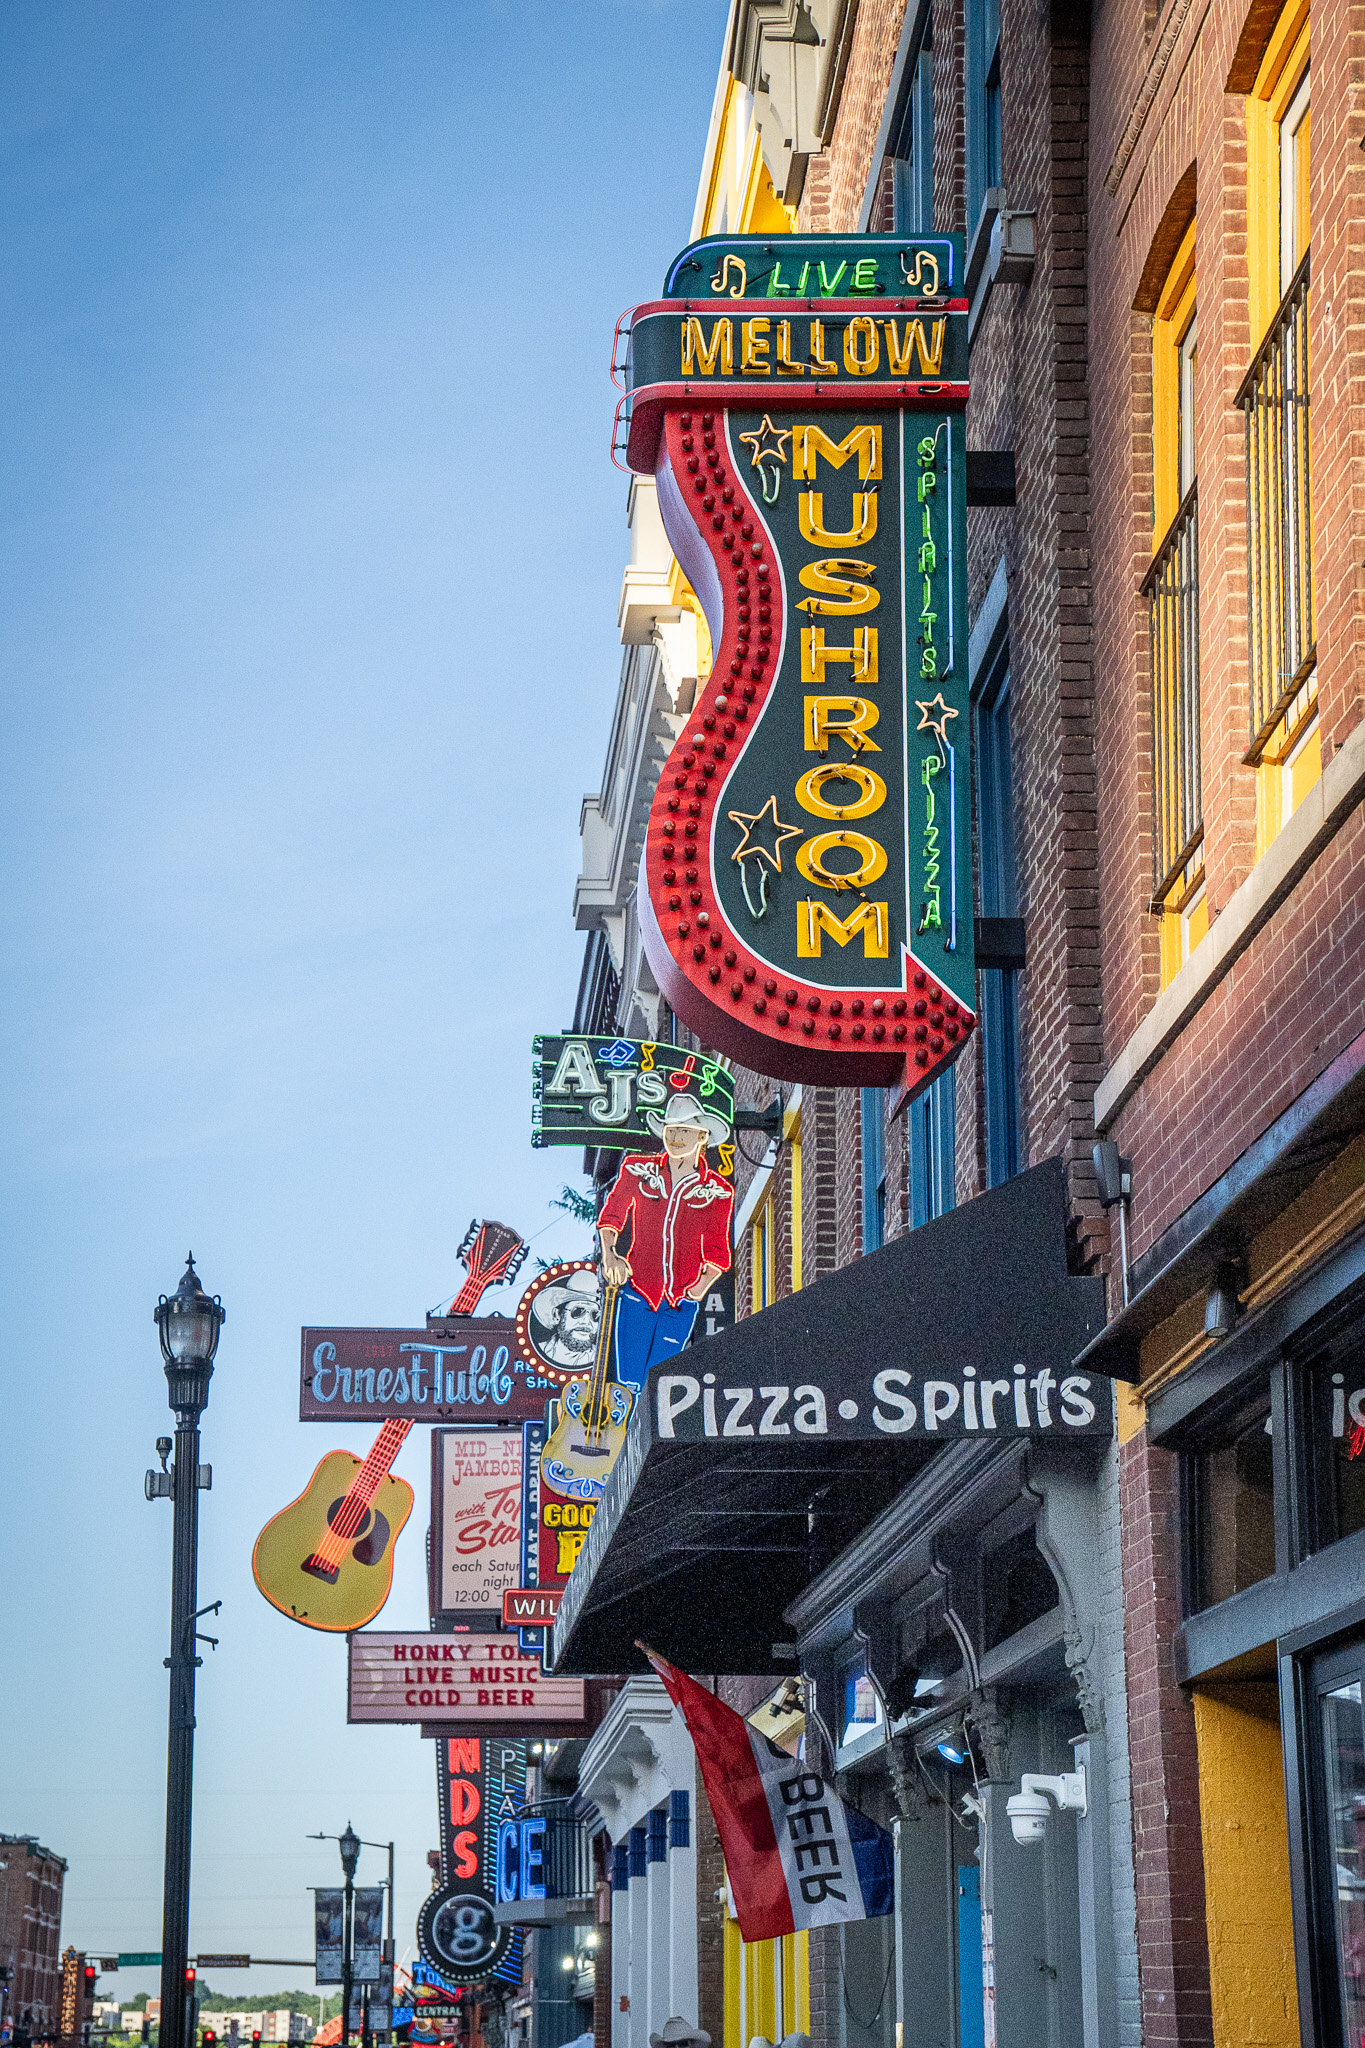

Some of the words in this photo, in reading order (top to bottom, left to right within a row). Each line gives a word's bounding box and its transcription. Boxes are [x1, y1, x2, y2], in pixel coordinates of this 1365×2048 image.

[767, 258, 880, 298] LIVE
[681, 316, 947, 375] MELLOW
[917, 436, 938, 679] SPIRITS
[792, 424, 889, 959] MUSHROOM
[922, 755, 942, 929] PIZZA
[312, 1341, 428, 1404] Ernest
[400, 1342, 514, 1405] Tubb
[657, 1373, 828, 1438] Pizza
[872, 1364, 1096, 1434] Spirits
[455, 1501, 486, 1519] with
[452, 1559, 482, 1572] each
[483, 1574, 514, 1590] night
[455, 1590, 490, 1603] 12:00
[393, 1644, 472, 1661] HONKY
[485, 1644, 540, 1661] TO
[404, 1667, 453, 1684] LIVE
[469, 1667, 538, 1684] MUSIC
[405, 1689, 461, 1706] COLD
[477, 1689, 534, 1706] BEER
[416, 2006, 462, 2016] CENTRAL
